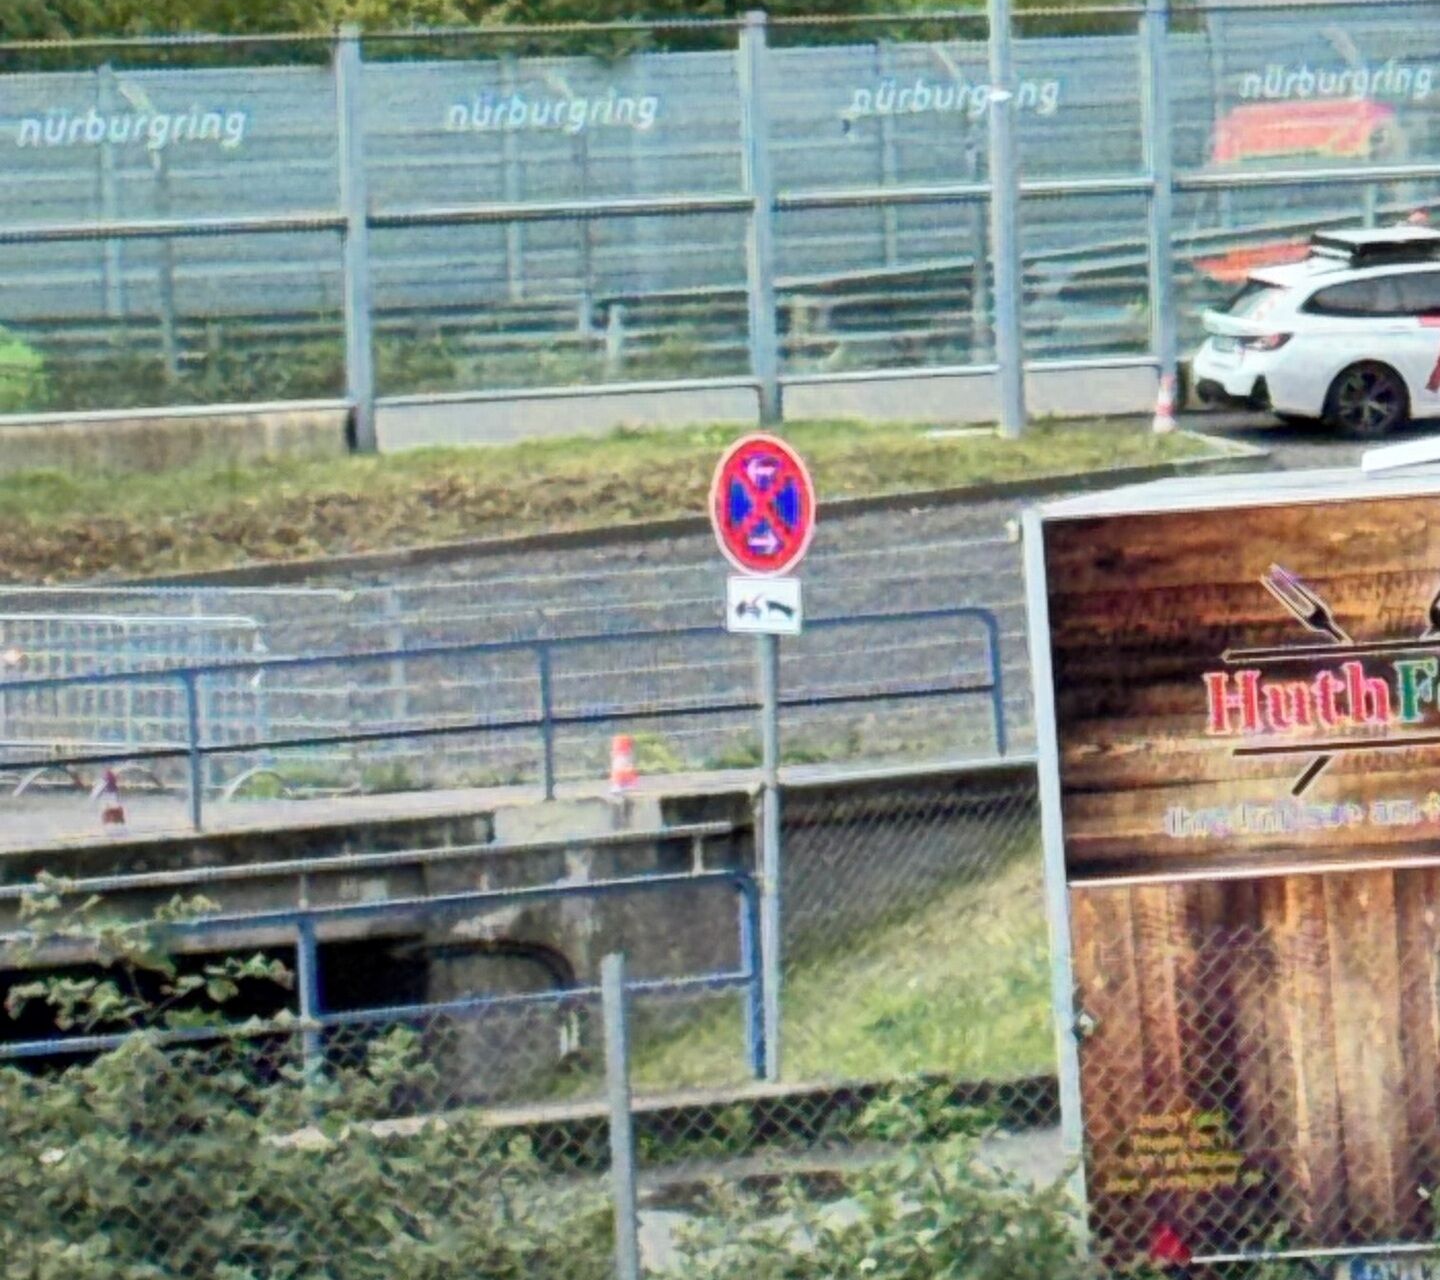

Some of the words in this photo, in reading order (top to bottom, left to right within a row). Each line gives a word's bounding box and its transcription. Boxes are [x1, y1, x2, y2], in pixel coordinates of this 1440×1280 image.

[1238, 58, 1435, 101] nürburgring
[16, 103, 248, 151] nürburgring
[448, 86, 659, 133] nürburgring
